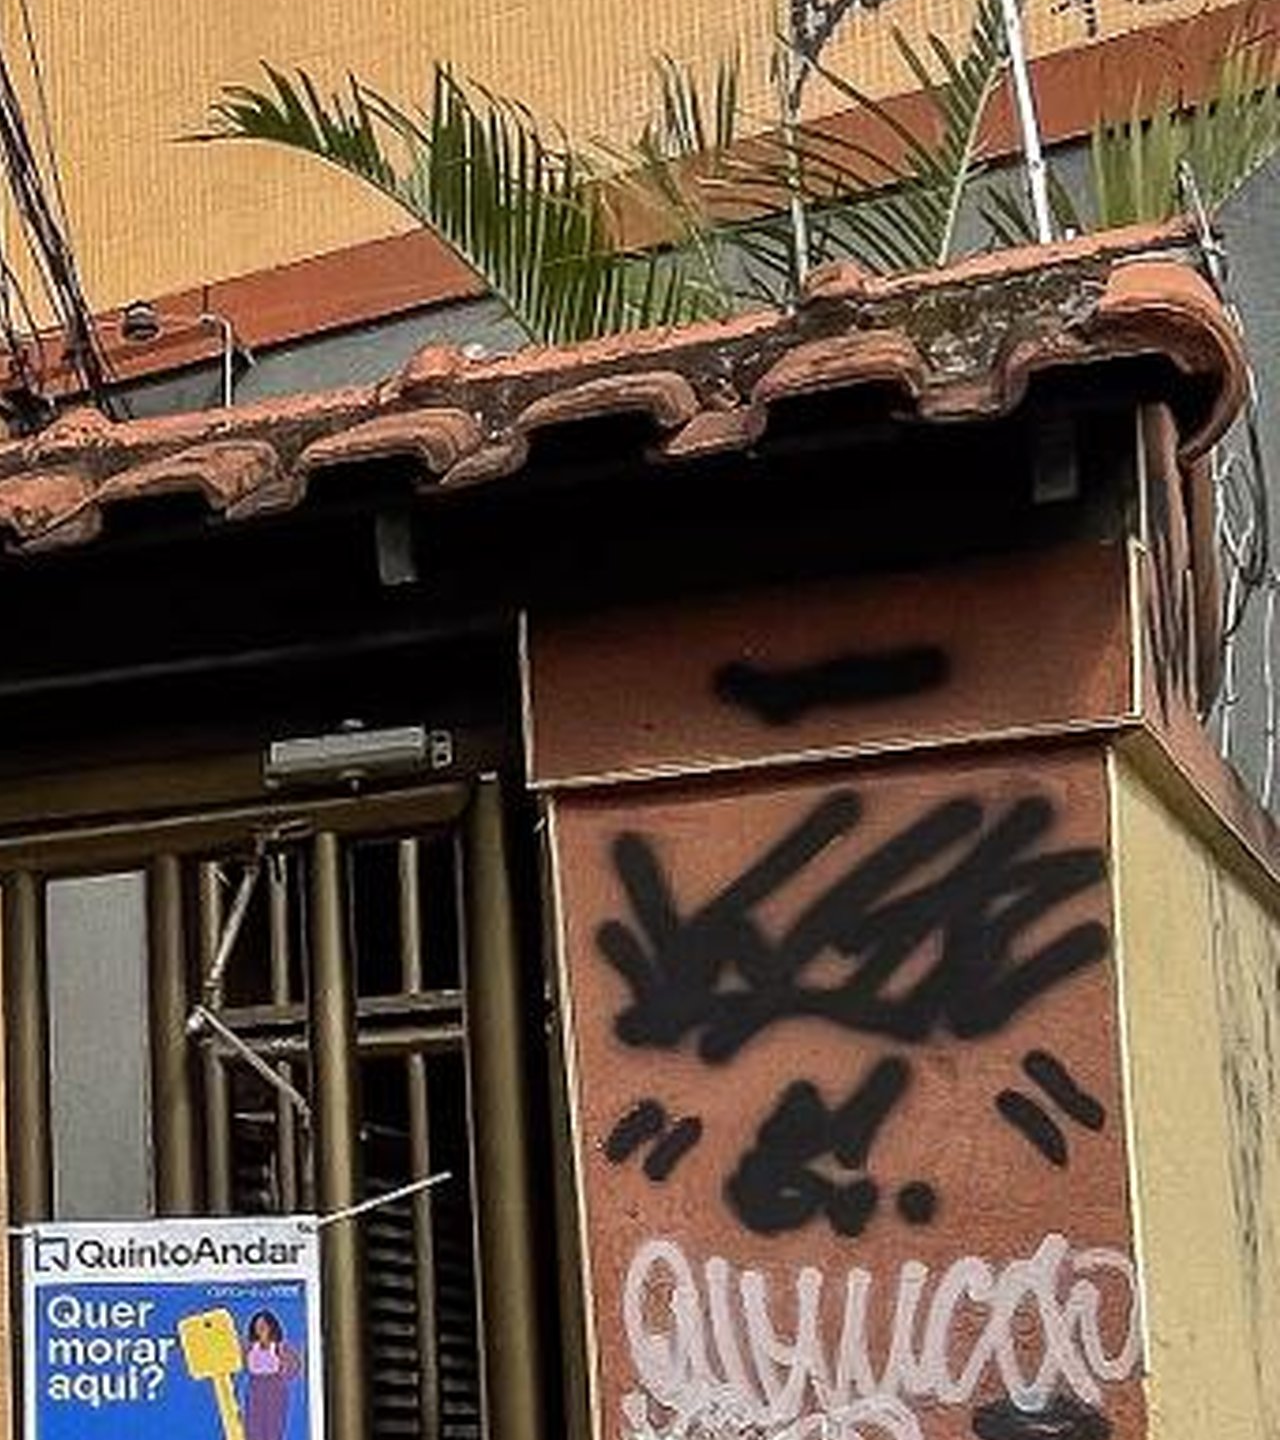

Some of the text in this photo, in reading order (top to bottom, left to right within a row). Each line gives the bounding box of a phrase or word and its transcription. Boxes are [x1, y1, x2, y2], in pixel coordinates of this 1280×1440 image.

[75, 1237, 306, 1269] QuintoAndar
[47, 1294, 155, 1329] Quer
[48, 1335, 176, 1365] morar
[47, 1365, 165, 1408] aqui?
